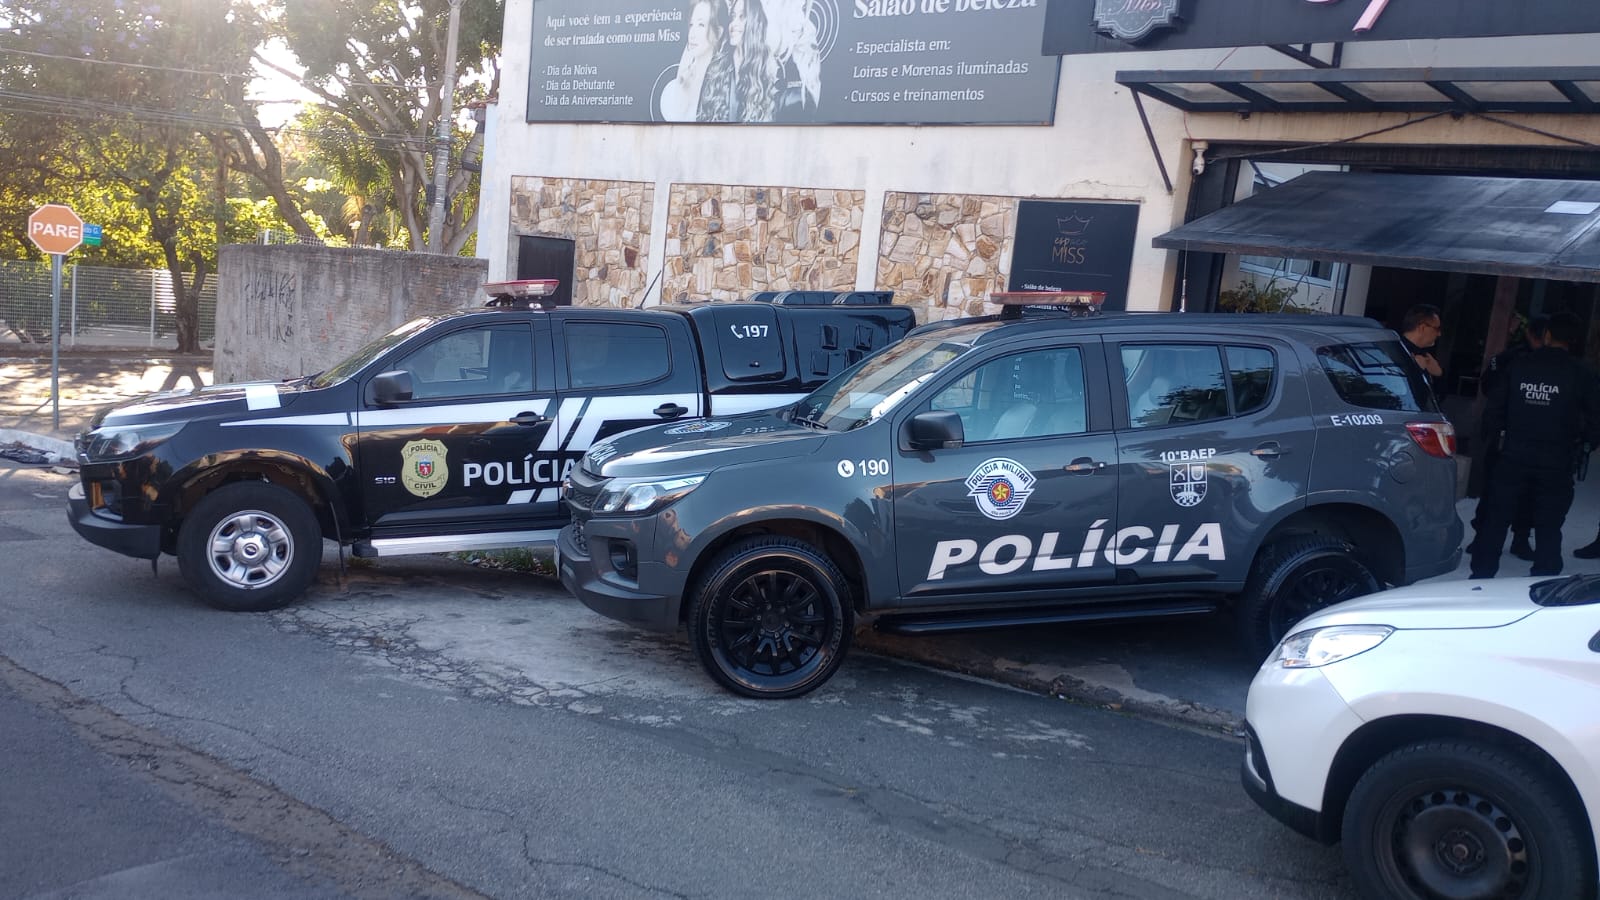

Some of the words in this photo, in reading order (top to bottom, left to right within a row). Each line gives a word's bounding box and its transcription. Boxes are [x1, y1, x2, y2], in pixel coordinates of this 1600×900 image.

[920, 0, 950, 13] de
[545, 15, 566, 31] Aqui
[568, 14, 590, 26] você
[593, 15, 611, 25] tem
[614, 14, 621, 24] a
[624, 8, 682, 27] experiência
[544, 35, 556, 47] de
[556, 36, 571, 46] ser
[572, 33, 605, 45] tratada
[606, 34, 633, 44] como
[634, 32, 656, 42] uma
[657, 29, 681, 42] Miss
[856, 39, 926, 56] Especialista
[928, 40, 951, 51] em:
[547, 64, 560, 76] Dia
[561, 64, 572, 76] da
[573, 64, 598, 76] Noiva
[853, 66, 888, 79] Loiras
[891, 67, 899, 77] e
[901, 63, 953, 77] Morenas
[956, 60, 1029, 75] iluminadas
[545, 80, 559, 91] Dia
[560, 79, 571, 91] da
[572, 79, 616, 90] Debutante
[544, 95, 558, 106] Dia
[559, 94, 570, 106] da
[571, 94, 634, 106] Aniversariante
[850, 90, 890, 102] Cursos
[892, 90, 901, 101] e
[903, 87, 985, 101] treinamentos
[32, 221, 80, 239] PARE
[1052, 246, 1086, 265] MISS
[742, 325, 769, 338] 197
[1519, 382, 1560, 394] POLÍCIA
[1525, 391, 1551, 401] CIVIL
[1330, 414, 1384, 427] E-10209
[410, 443, 438, 452] POLÍCIA
[463, 453, 576, 487] POLÍCIA
[858, 459, 890, 476] 190
[1001, 462, 1030, 484] MILITAR
[926, 519, 1226, 581] POLÍCIA
